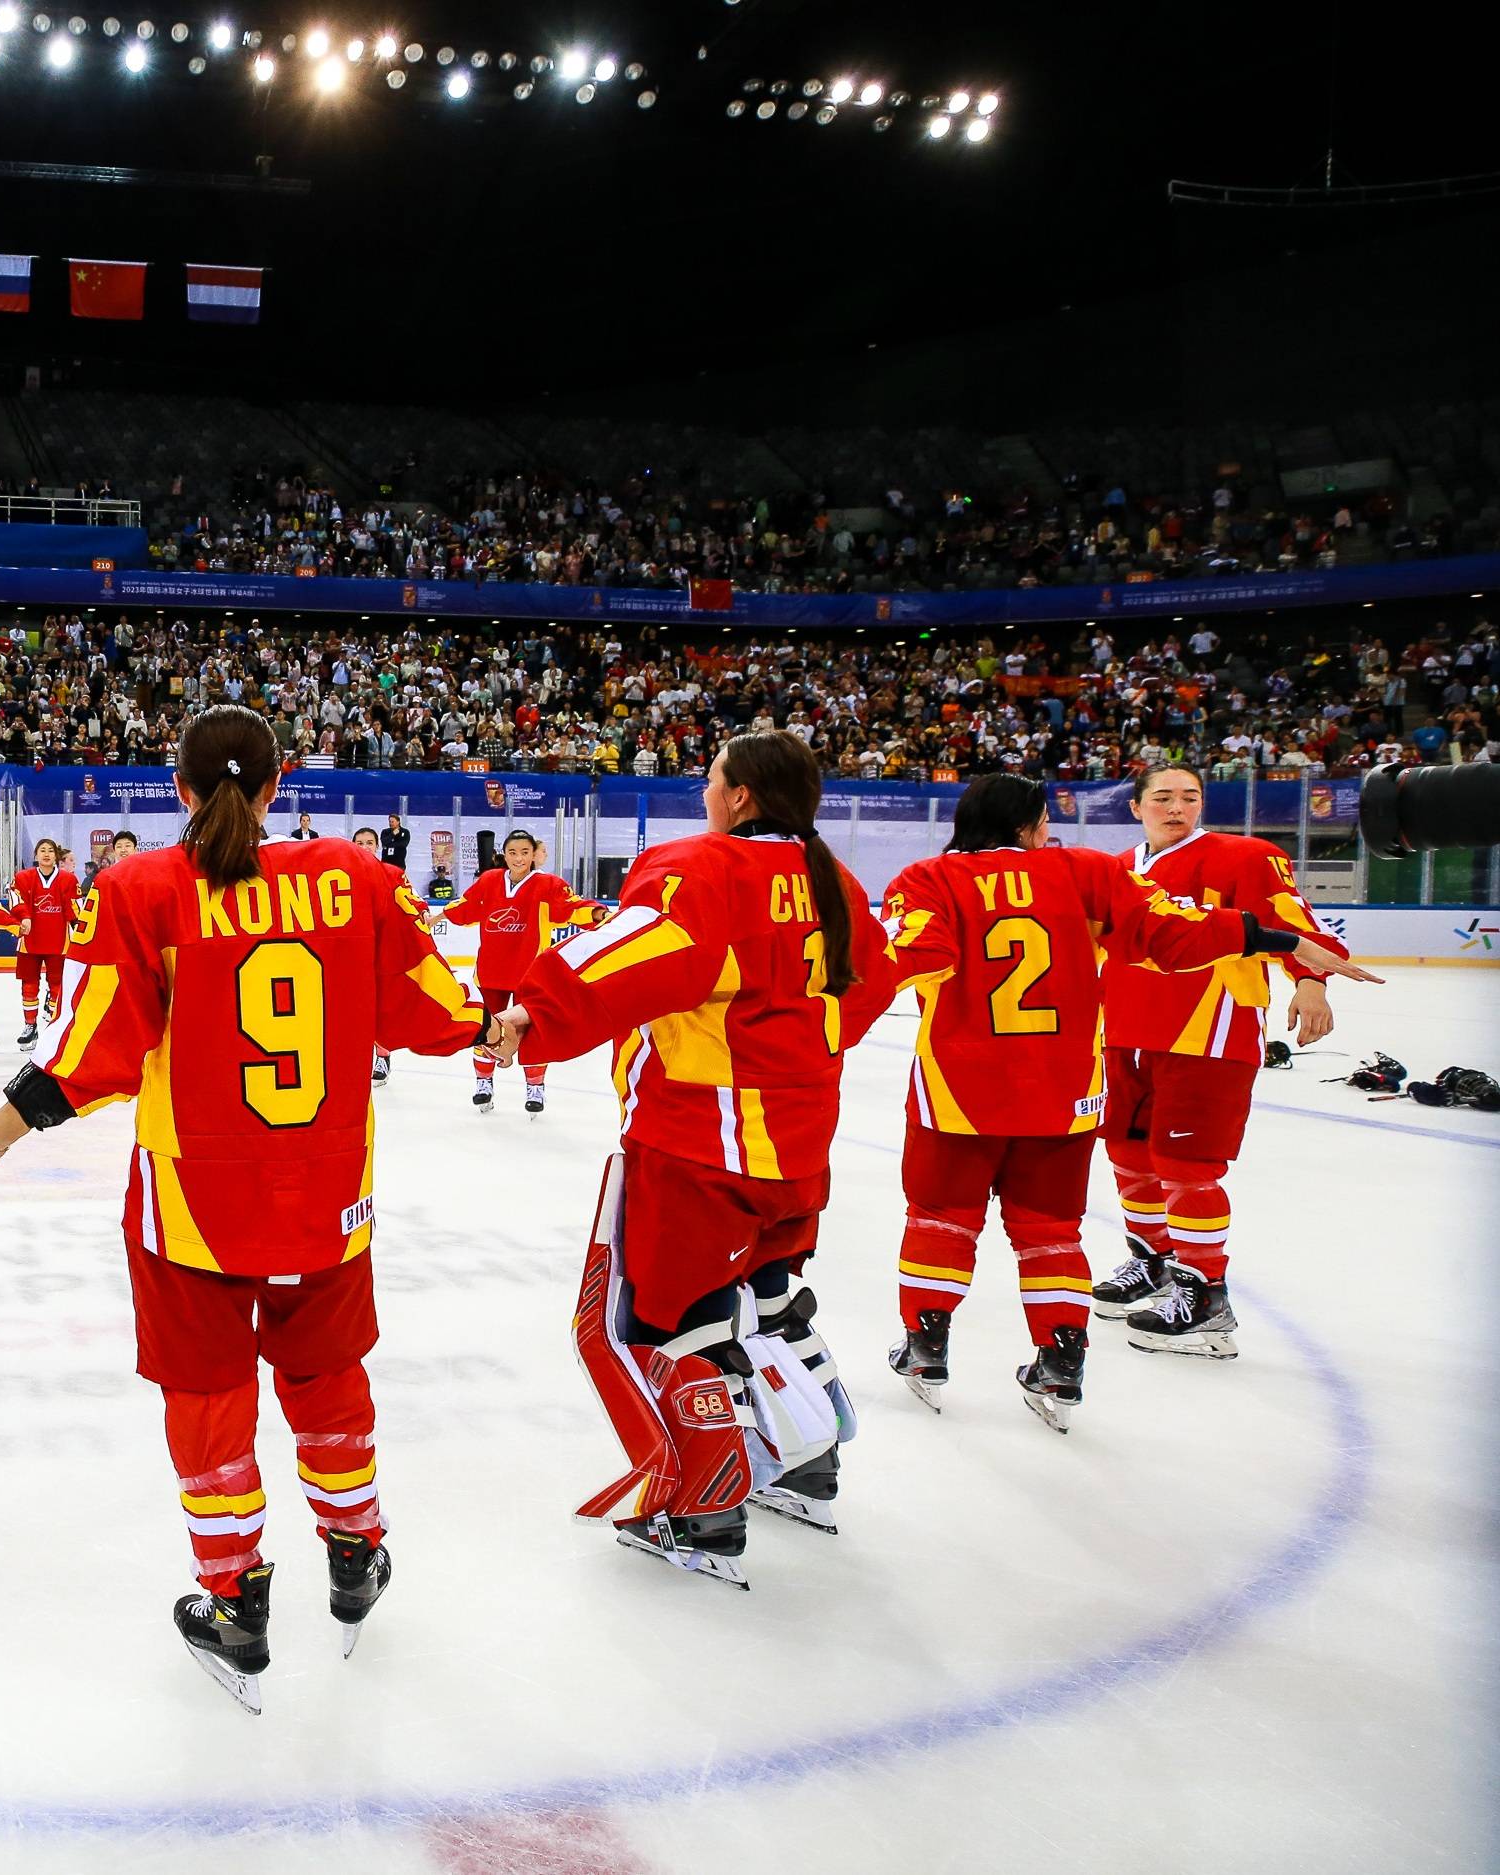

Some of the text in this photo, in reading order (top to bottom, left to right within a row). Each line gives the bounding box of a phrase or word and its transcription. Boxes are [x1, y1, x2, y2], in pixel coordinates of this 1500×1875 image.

[96, 562, 111, 570] 210
[467, 764, 485, 773] 115
[974, 870, 1034, 912] YU
[1266, 855, 1295, 888] 15
[196, 868, 353, 938] KONG
[661, 874, 683, 914] 1
[983, 913, 1061, 1036] 2
[234, 938, 328, 1130] 9
[693, 1392, 725, 1417] 88
